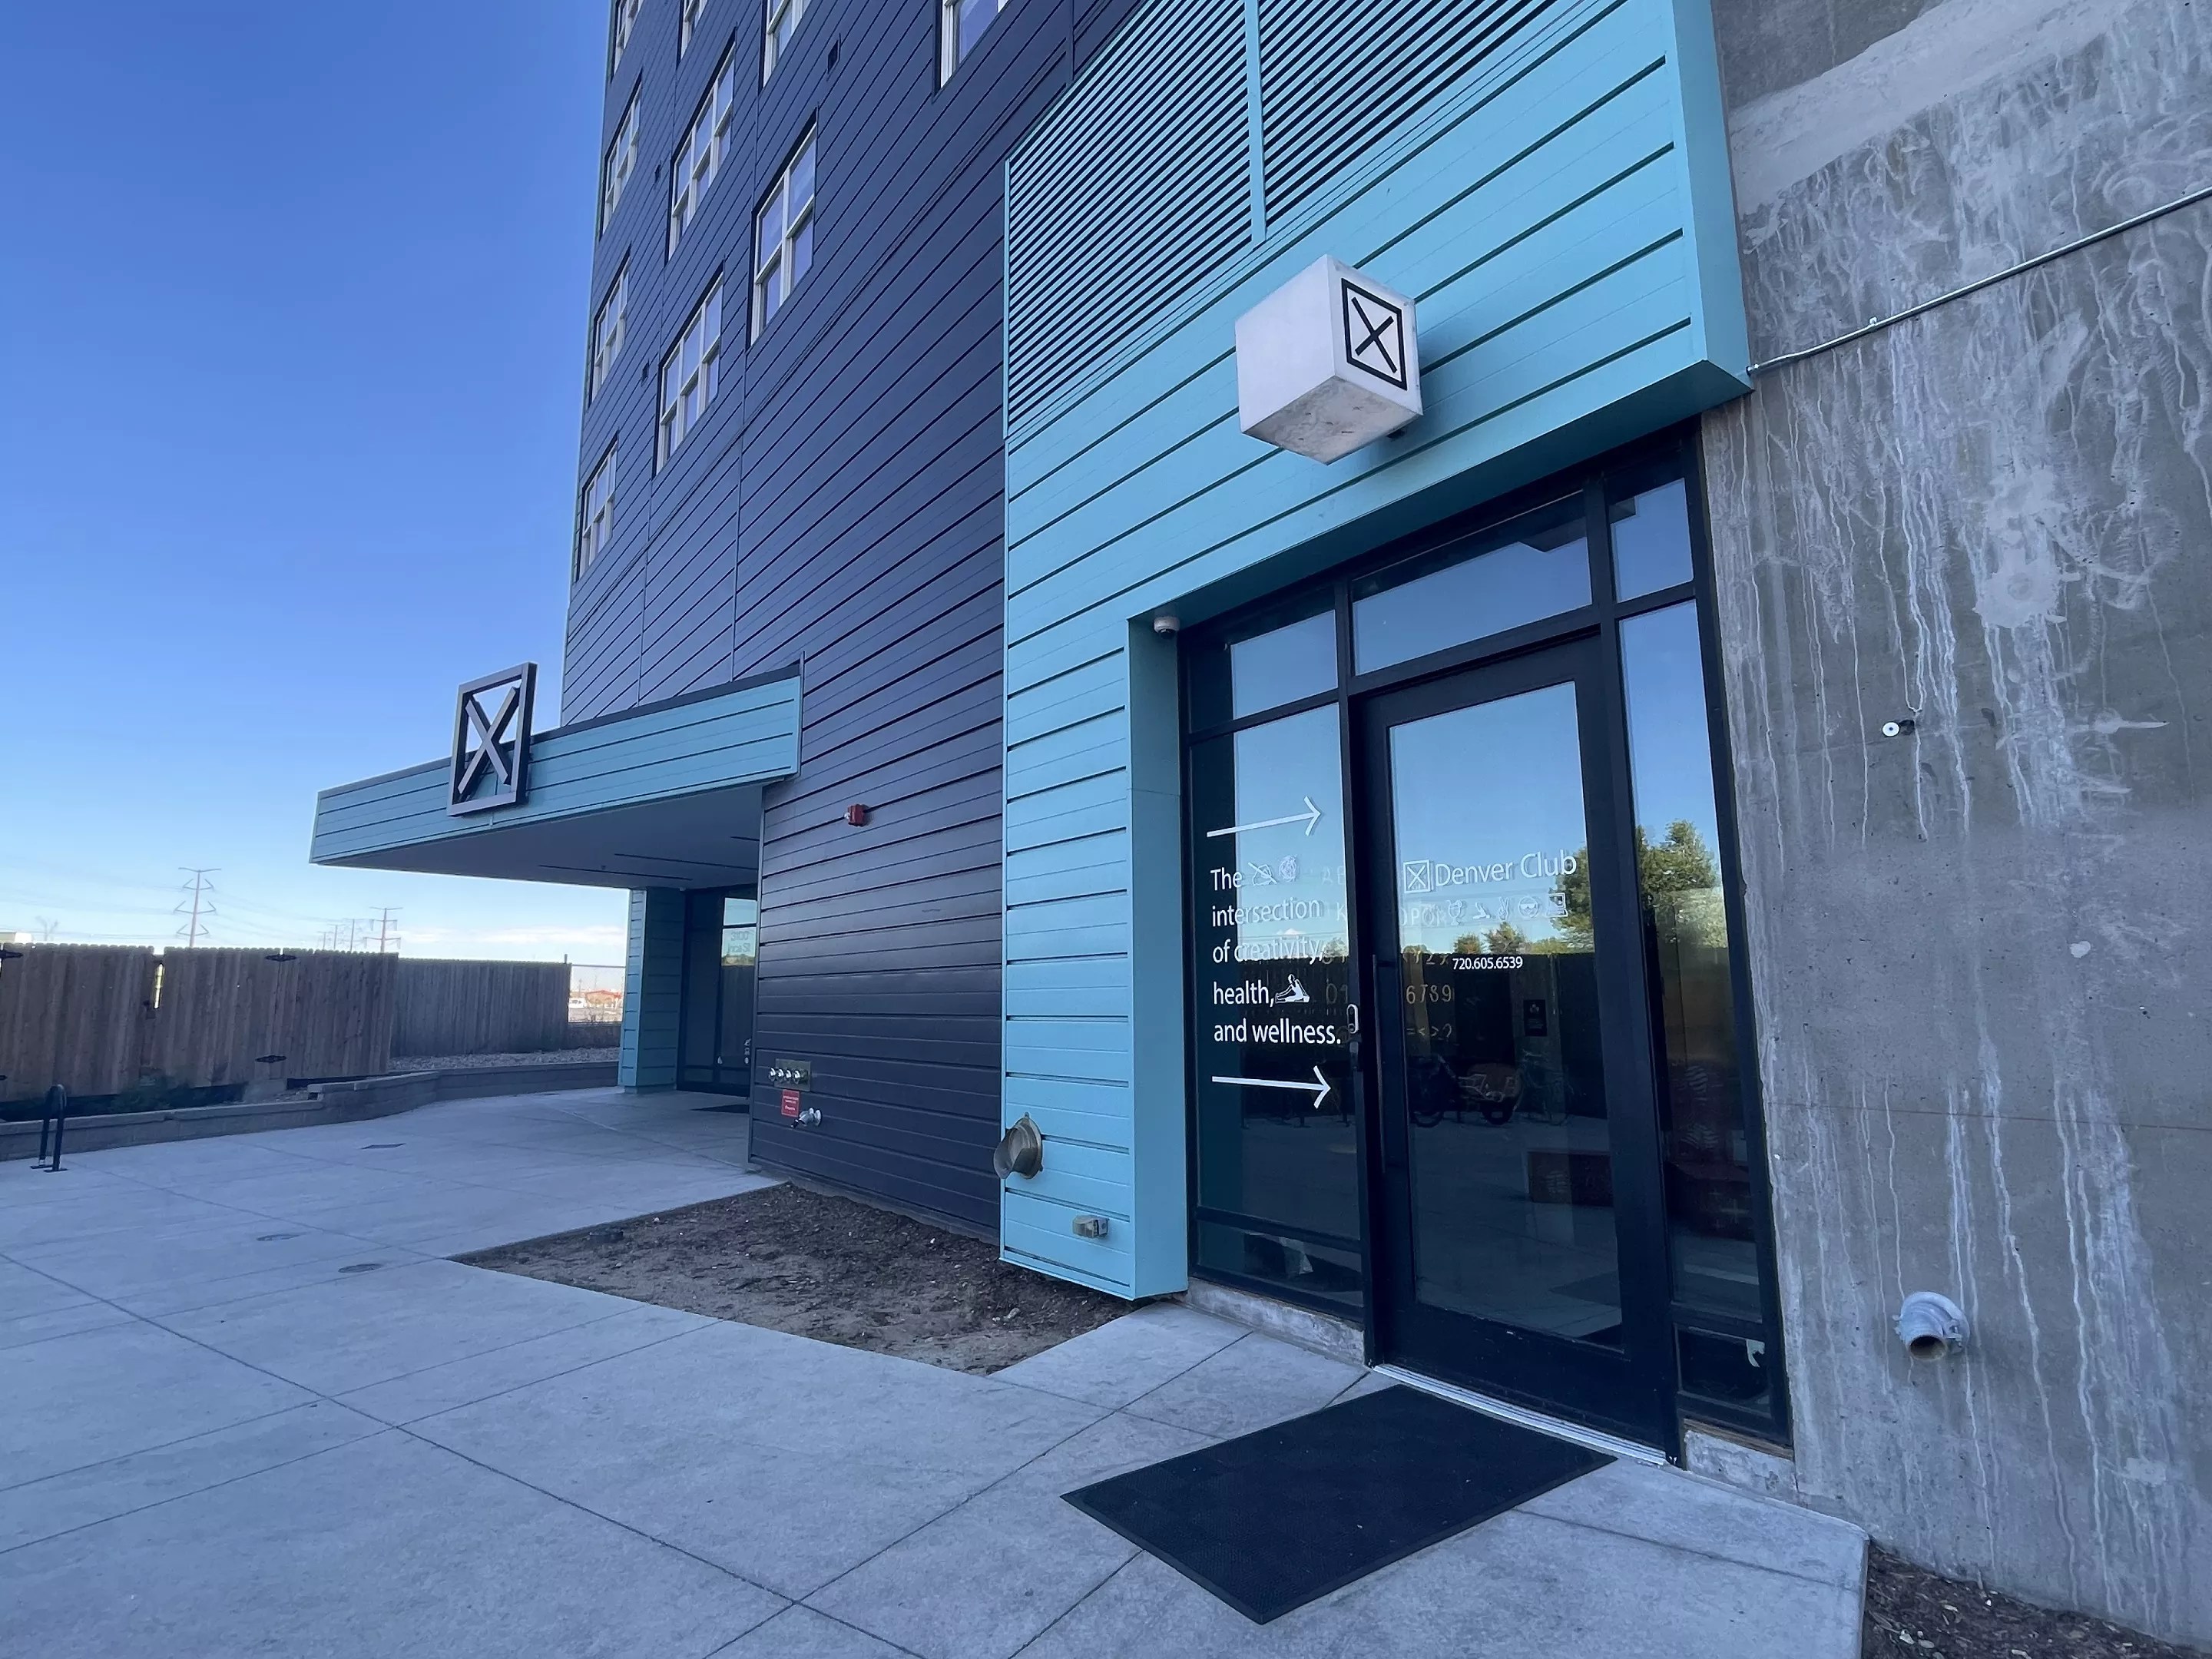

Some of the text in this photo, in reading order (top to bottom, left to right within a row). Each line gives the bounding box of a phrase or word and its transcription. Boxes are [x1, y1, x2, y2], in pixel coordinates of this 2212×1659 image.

[1210, 866, 1243, 891] The
[1434, 860, 1514, 886] Denver
[1521, 849, 1577, 878] Club
[1212, 896, 1321, 927] intersection
[1213, 939, 1231, 963] of
[1234, 937, 1326, 965] creativity,
[1452, 955, 1524, 971] 720.605.6539
[1214, 980, 1275, 1007] health,
[1214, 1018, 1342, 1045] and wellness.
